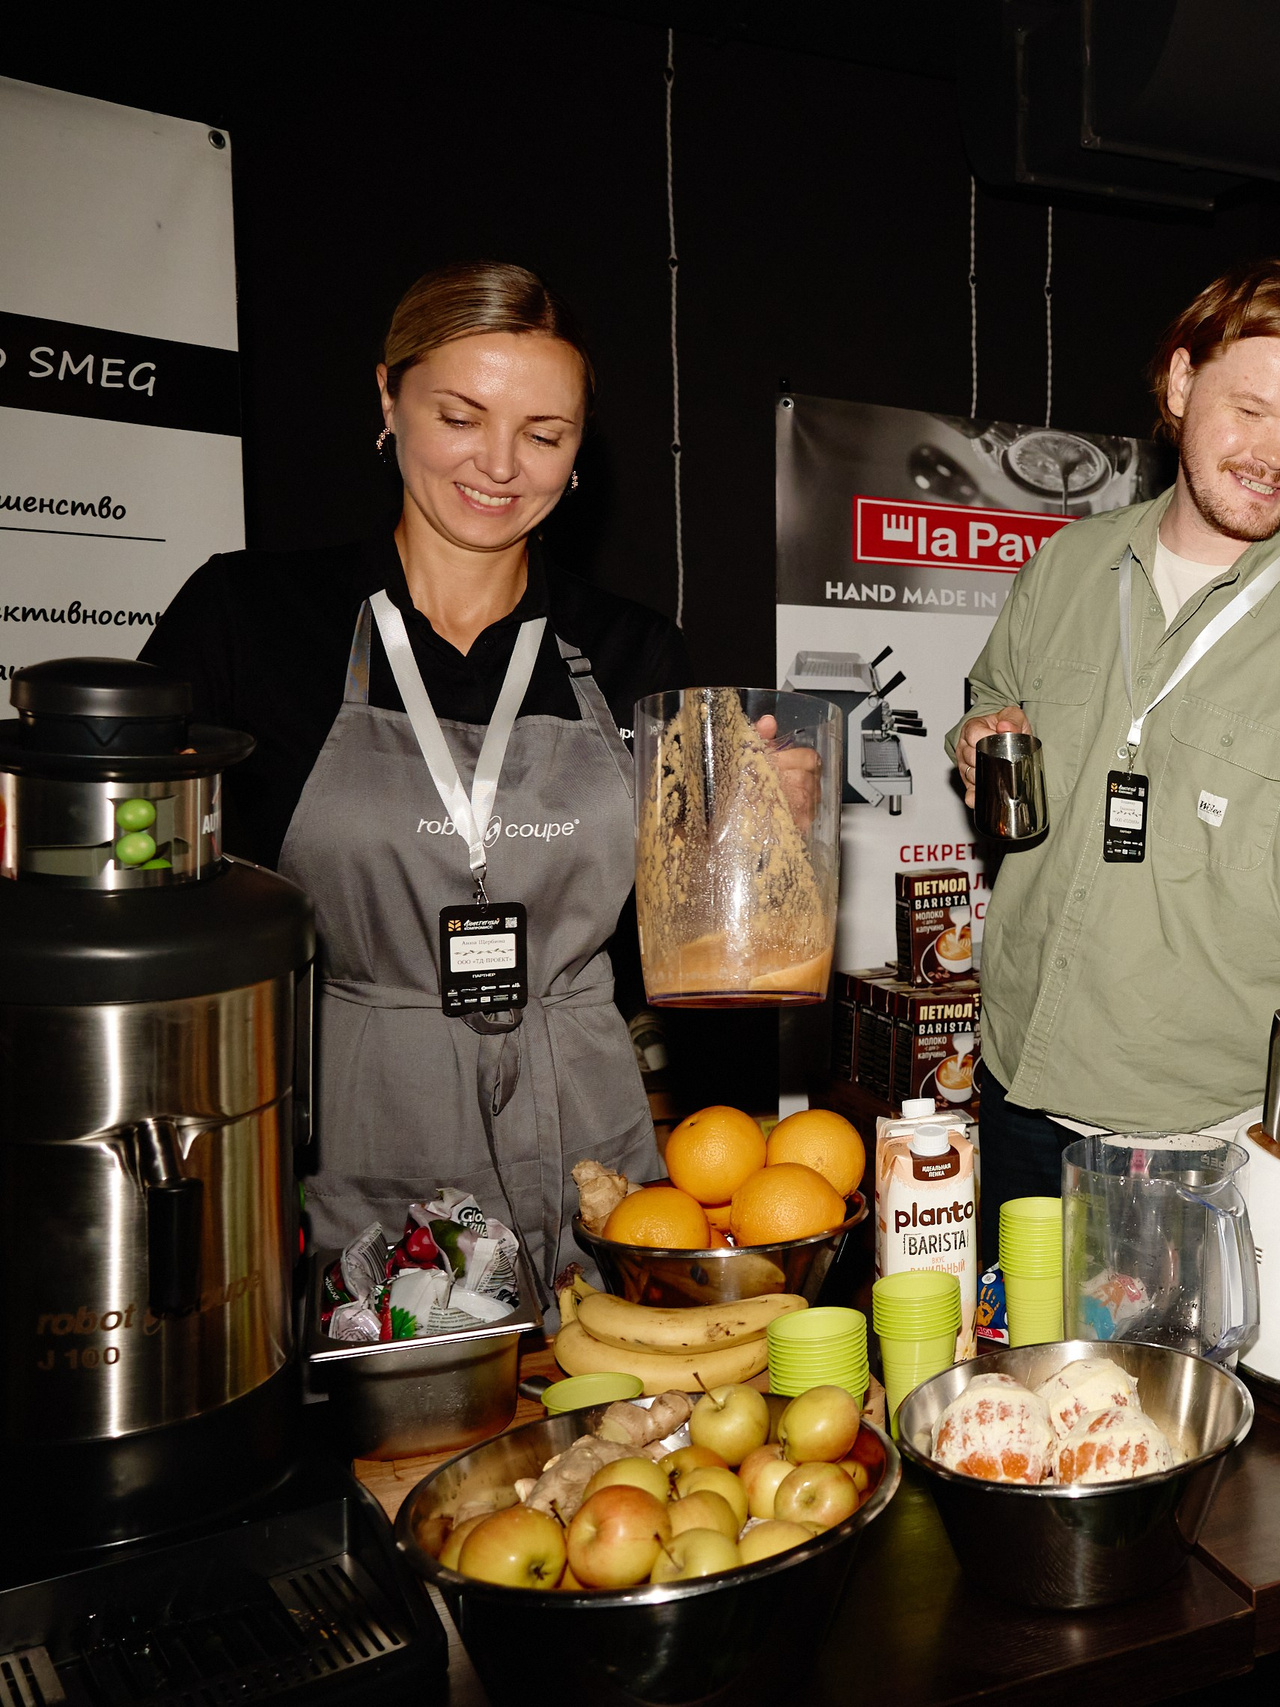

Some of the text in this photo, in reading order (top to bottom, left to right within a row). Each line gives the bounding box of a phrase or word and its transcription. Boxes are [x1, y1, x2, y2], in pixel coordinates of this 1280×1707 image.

[28, 346, 157, 397] SMEG
[917, 516, 958, 558] la
[825, 580, 997, 608] HAND MADE IN
[416, 816, 575, 842] rob coupe
[914, 877, 967, 897] ПЕТМОЛ
[915, 895, 968, 910] BARISTA
[919, 1003, 973, 1021] ПЕТМОЛ
[918, 1021, 972, 1035] BARISTA
[894, 1200, 975, 1234] planto
[908, 1229, 967, 1256] BARISTA
[36, 1303, 137, 1337] robot
[63, 1346, 121, 1370] 100
